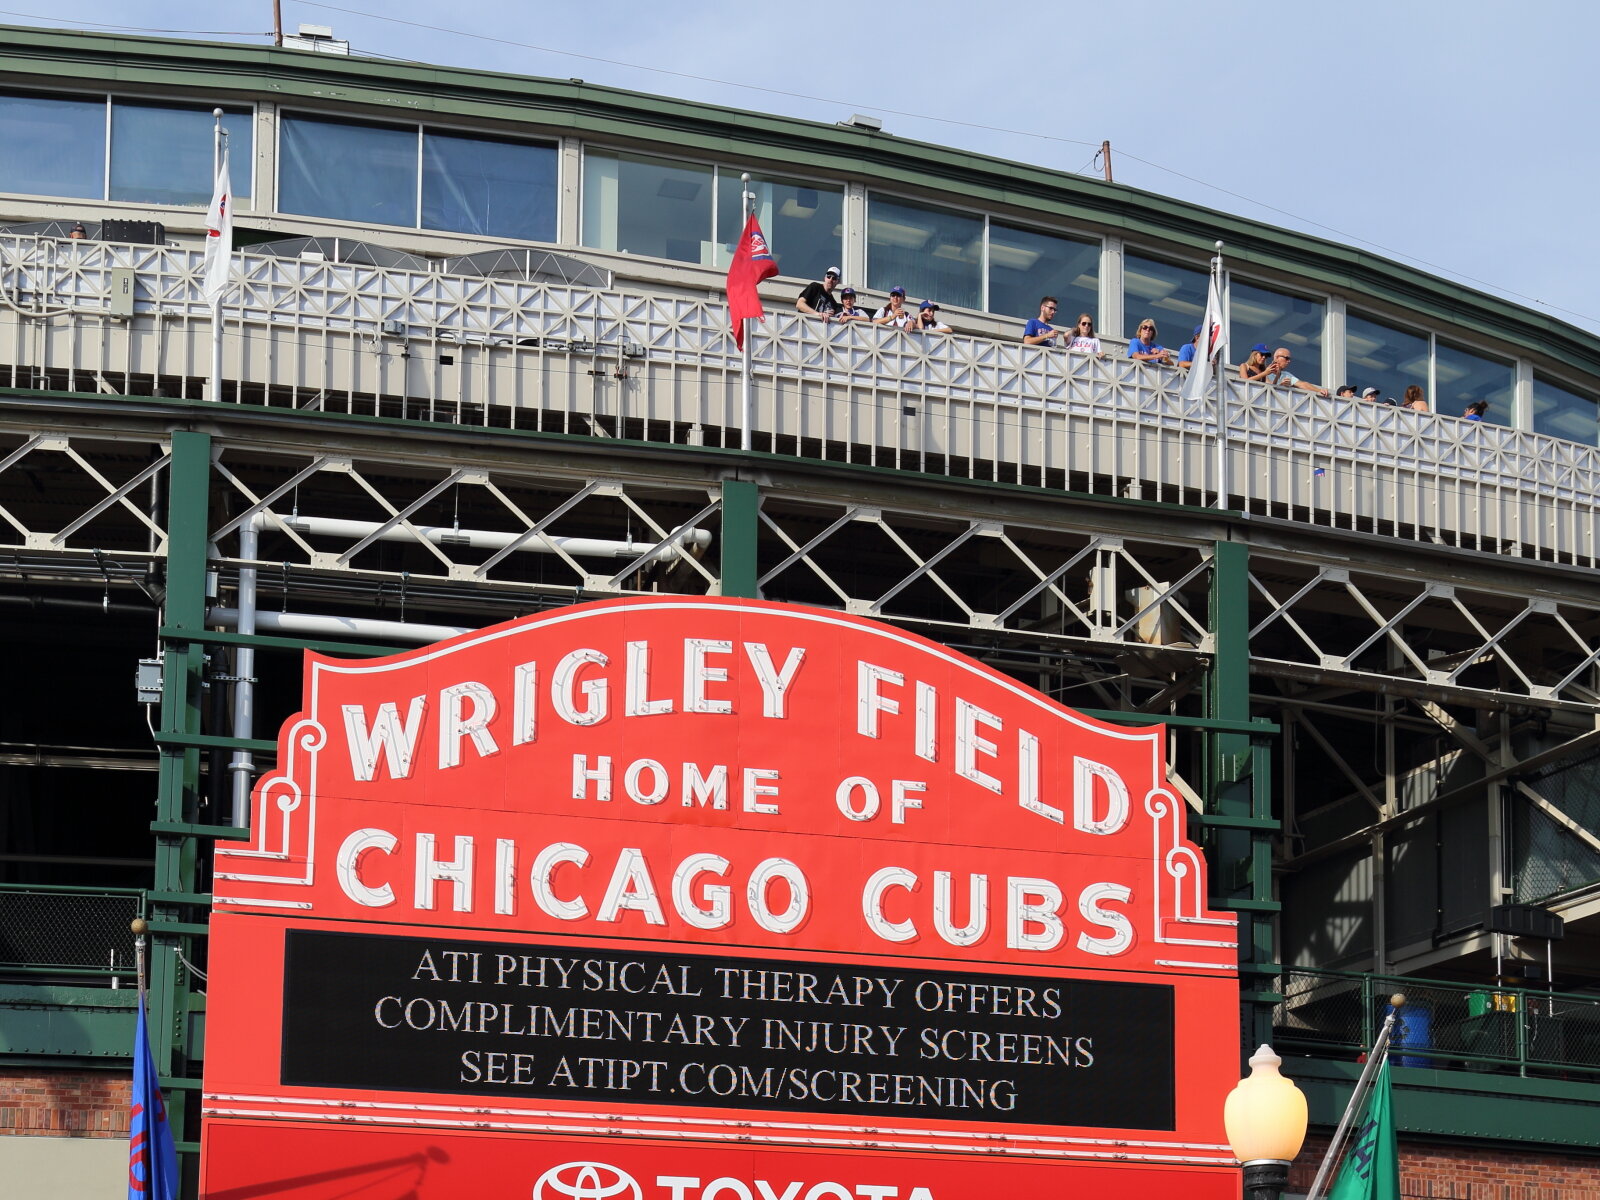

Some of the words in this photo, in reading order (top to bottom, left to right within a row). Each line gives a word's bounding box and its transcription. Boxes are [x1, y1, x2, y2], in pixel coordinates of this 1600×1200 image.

[342, 639, 806, 781] WRIGLEY
[858, 661, 1130, 836] FIELD
[573, 754, 780, 815] HOME
[836, 777, 928, 825] OF
[337, 828, 809, 934] CHICAGO
[863, 867, 1134, 956] CUBS
[411, 948, 484, 985] ATI
[494, 954, 703, 998] PHYSICAL
[714, 967, 905, 1010] THERAPY
[915, 980, 1062, 1019] OFFERS
[374, 995, 751, 1048] COMPLIMENTARY
[761, 1018, 908, 1058] INJURY
[920, 1027, 1095, 1068] SCREENS
[460, 1050, 536, 1085] SEE
[547, 1055, 1019, 1111] ATIPT.COM/SCREENING
